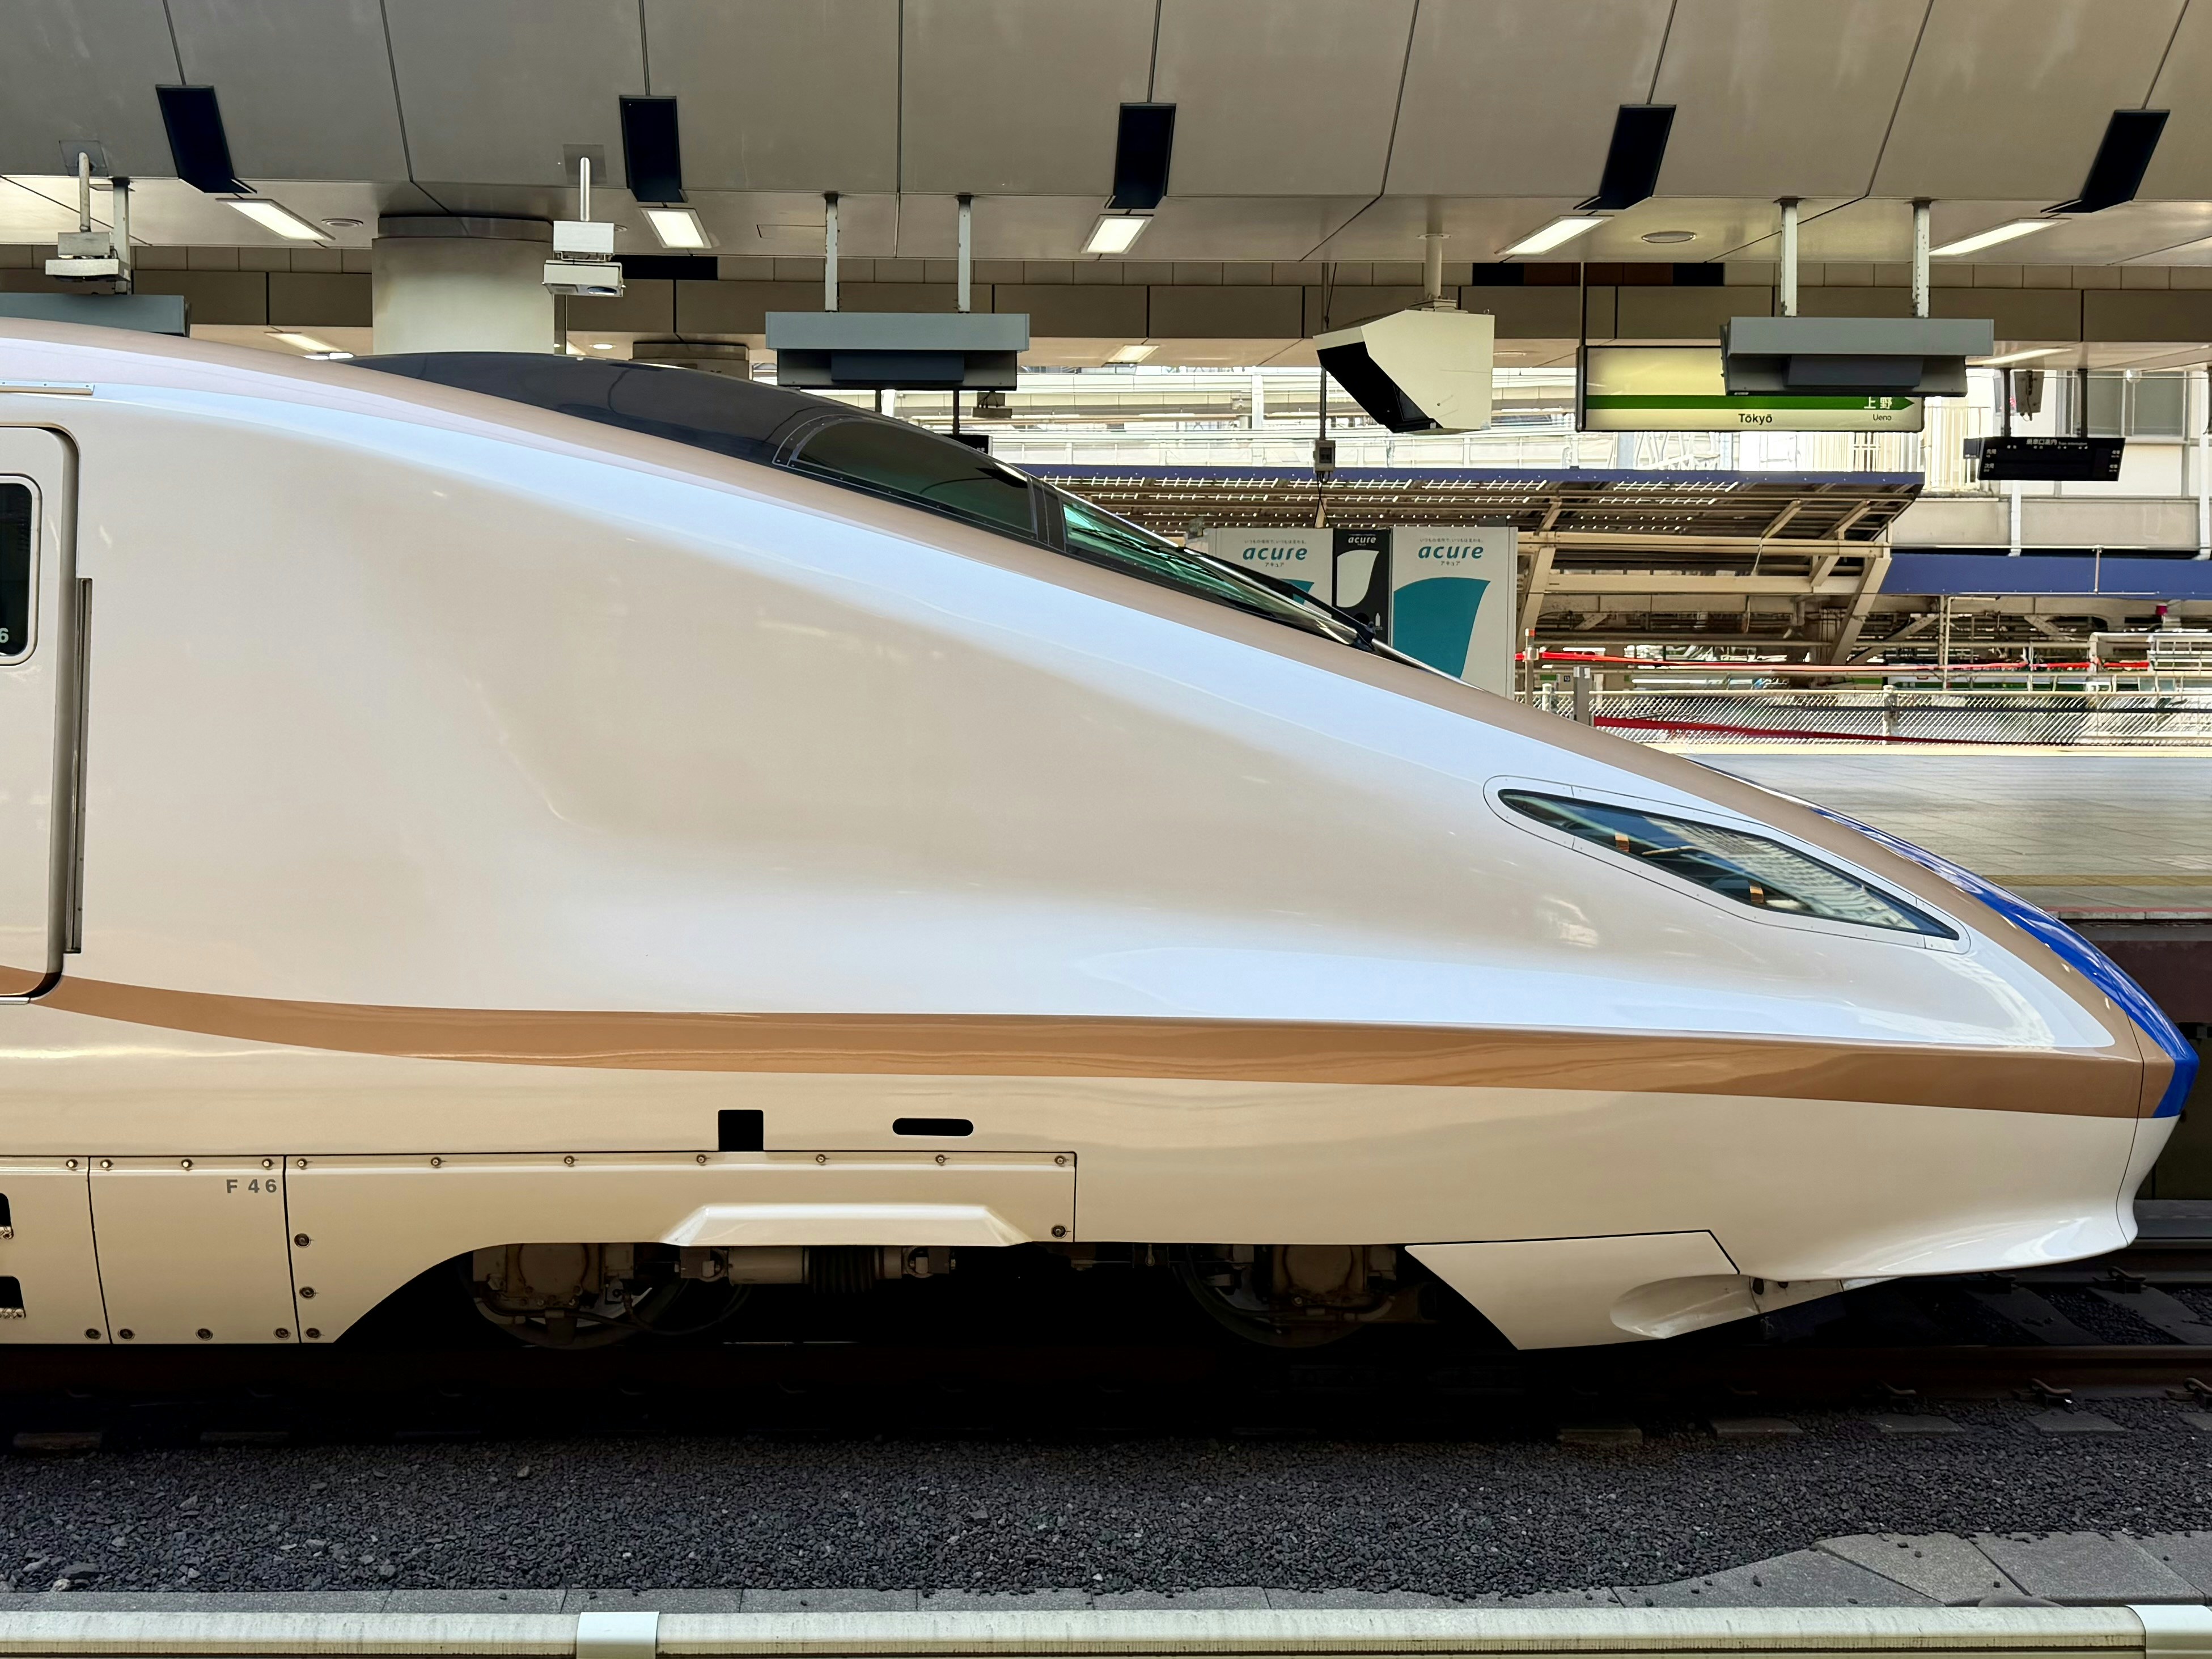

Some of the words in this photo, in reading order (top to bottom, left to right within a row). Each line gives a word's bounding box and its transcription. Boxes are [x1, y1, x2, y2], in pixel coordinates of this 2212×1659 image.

[1863, 396, 1892, 409] 上野
[1738, 413, 1773, 425] Tōkyō
[1243, 547, 1308, 560] acure
[1418, 546, 1484, 559] acure
[0, 627, 9, 644] 6
